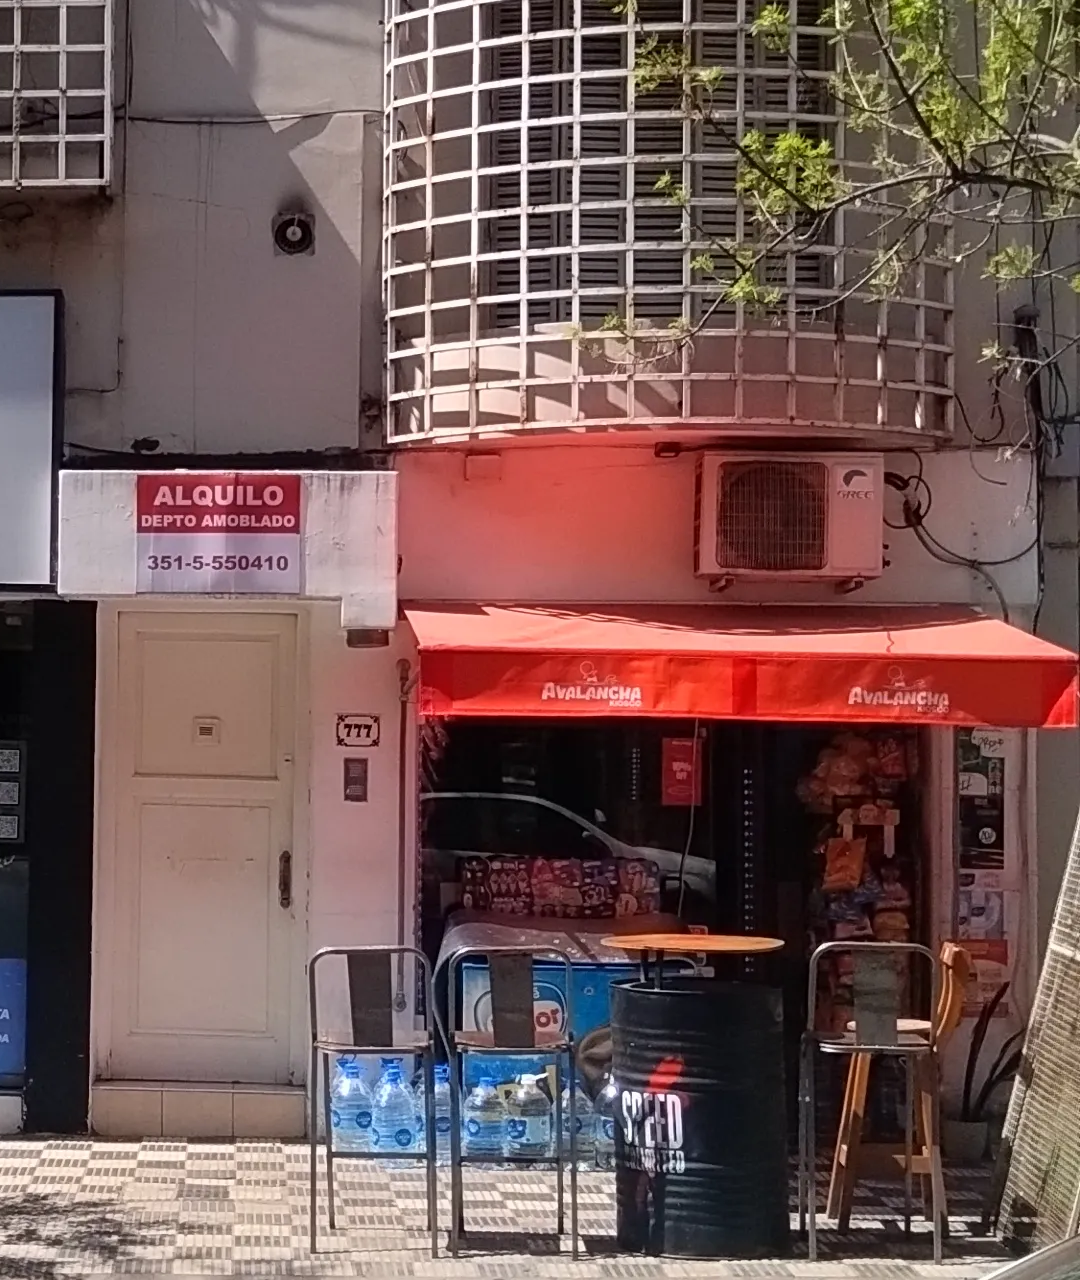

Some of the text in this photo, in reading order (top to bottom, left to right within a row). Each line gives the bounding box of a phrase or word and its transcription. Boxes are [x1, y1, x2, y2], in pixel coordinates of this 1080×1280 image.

[153, 485, 284, 507] ALQUILO
[141, 514, 296, 528] DEPTO AMOBLADO
[147, 555, 289, 571] 351-5-550410
[541, 682, 642, 701] AVALANCHA
[847, 686, 949, 706] AVALANCHA
[344, 723, 373, 738] 777
[622, 1090, 683, 1150] SPEED
